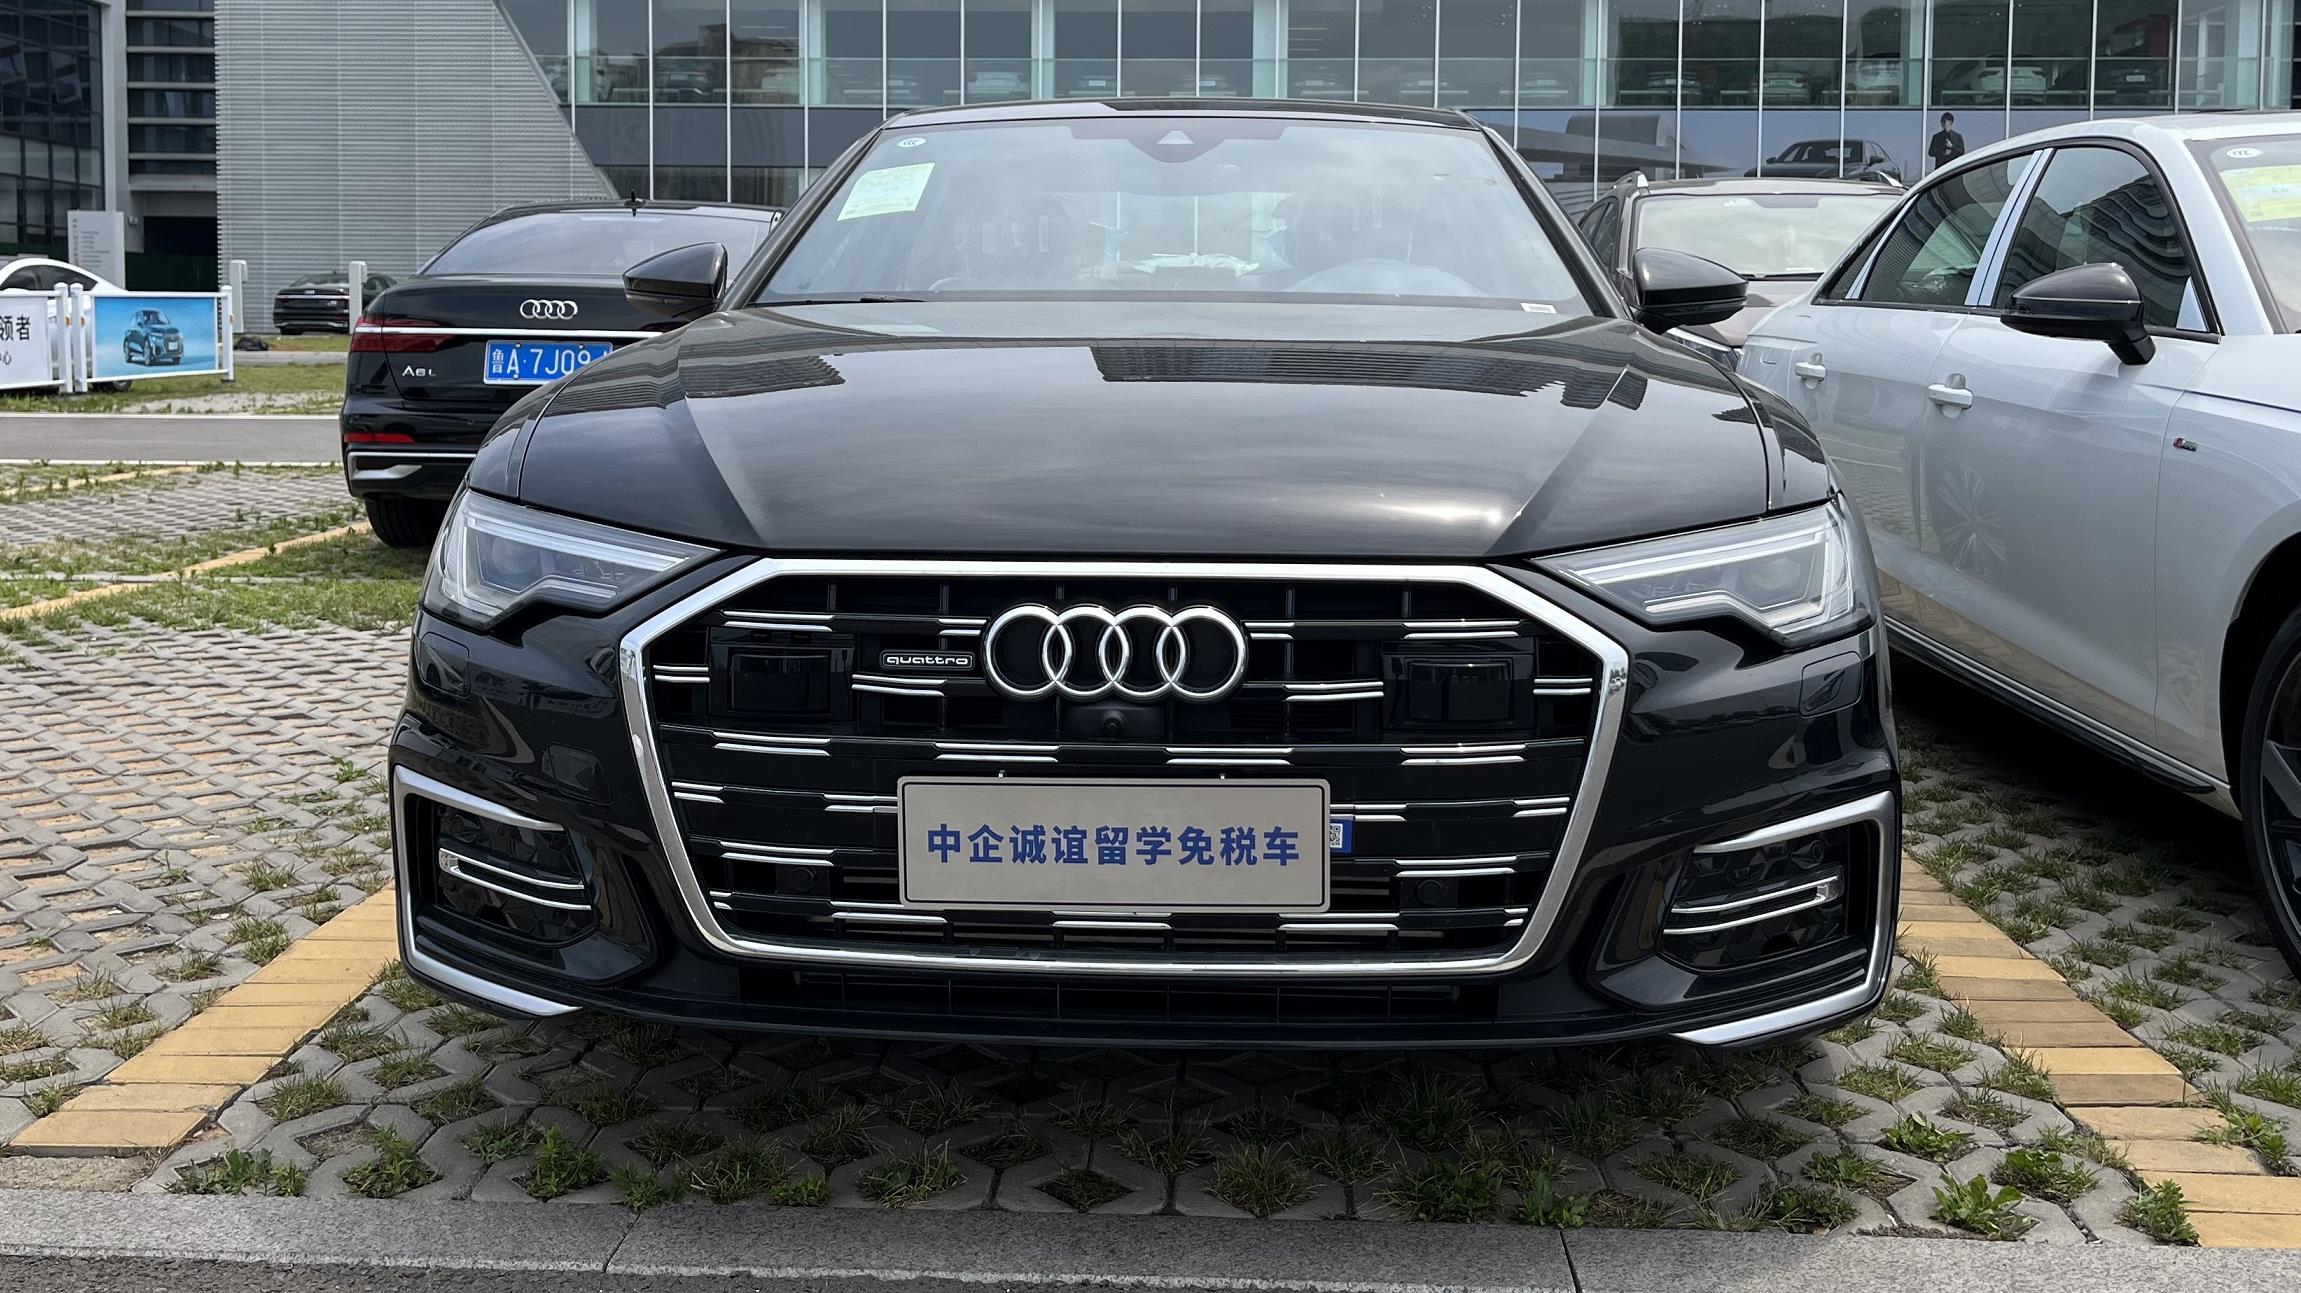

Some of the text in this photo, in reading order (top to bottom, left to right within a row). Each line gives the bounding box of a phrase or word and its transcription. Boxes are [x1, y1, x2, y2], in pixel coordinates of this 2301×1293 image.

[492, 348, 607, 376] 鲁A·7J09
[886, 656, 969, 665] quattro
[926, 823, 1300, 866] 中企诚谊留学免税车
